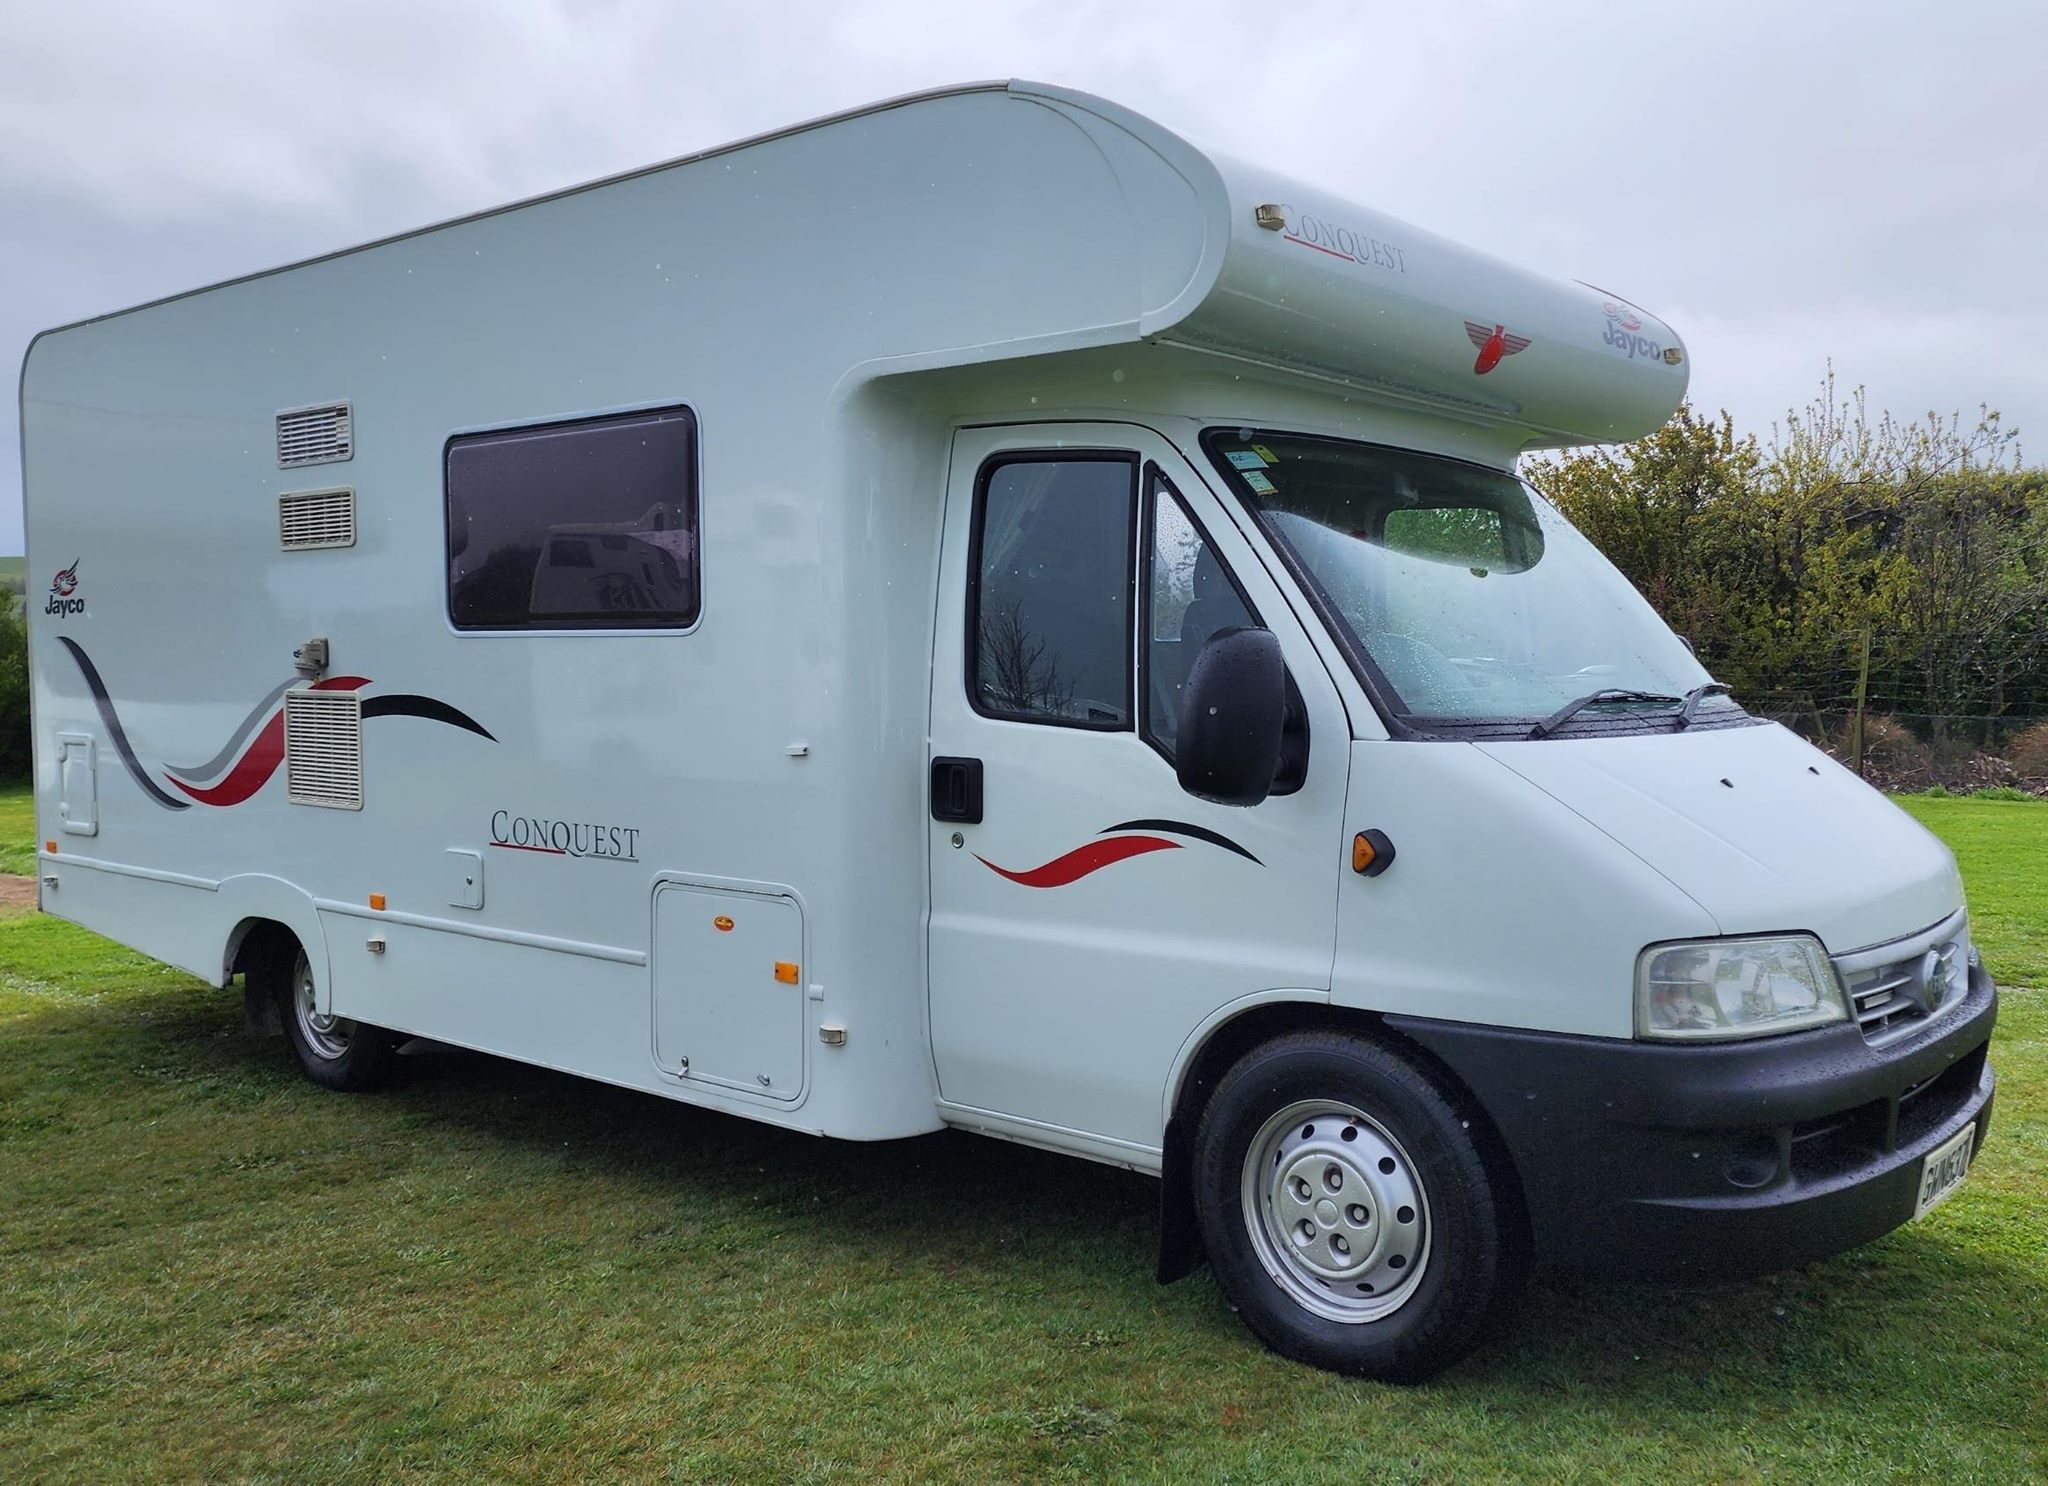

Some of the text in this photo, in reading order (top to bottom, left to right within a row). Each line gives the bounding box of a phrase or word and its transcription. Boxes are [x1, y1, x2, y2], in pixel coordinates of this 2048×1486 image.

[1281, 203, 1406, 273] CONQUEST
[1603, 319, 1660, 361] Jayco
[45, 594, 85, 619] Jayco
[491, 809, 640, 858] CONQUEST
